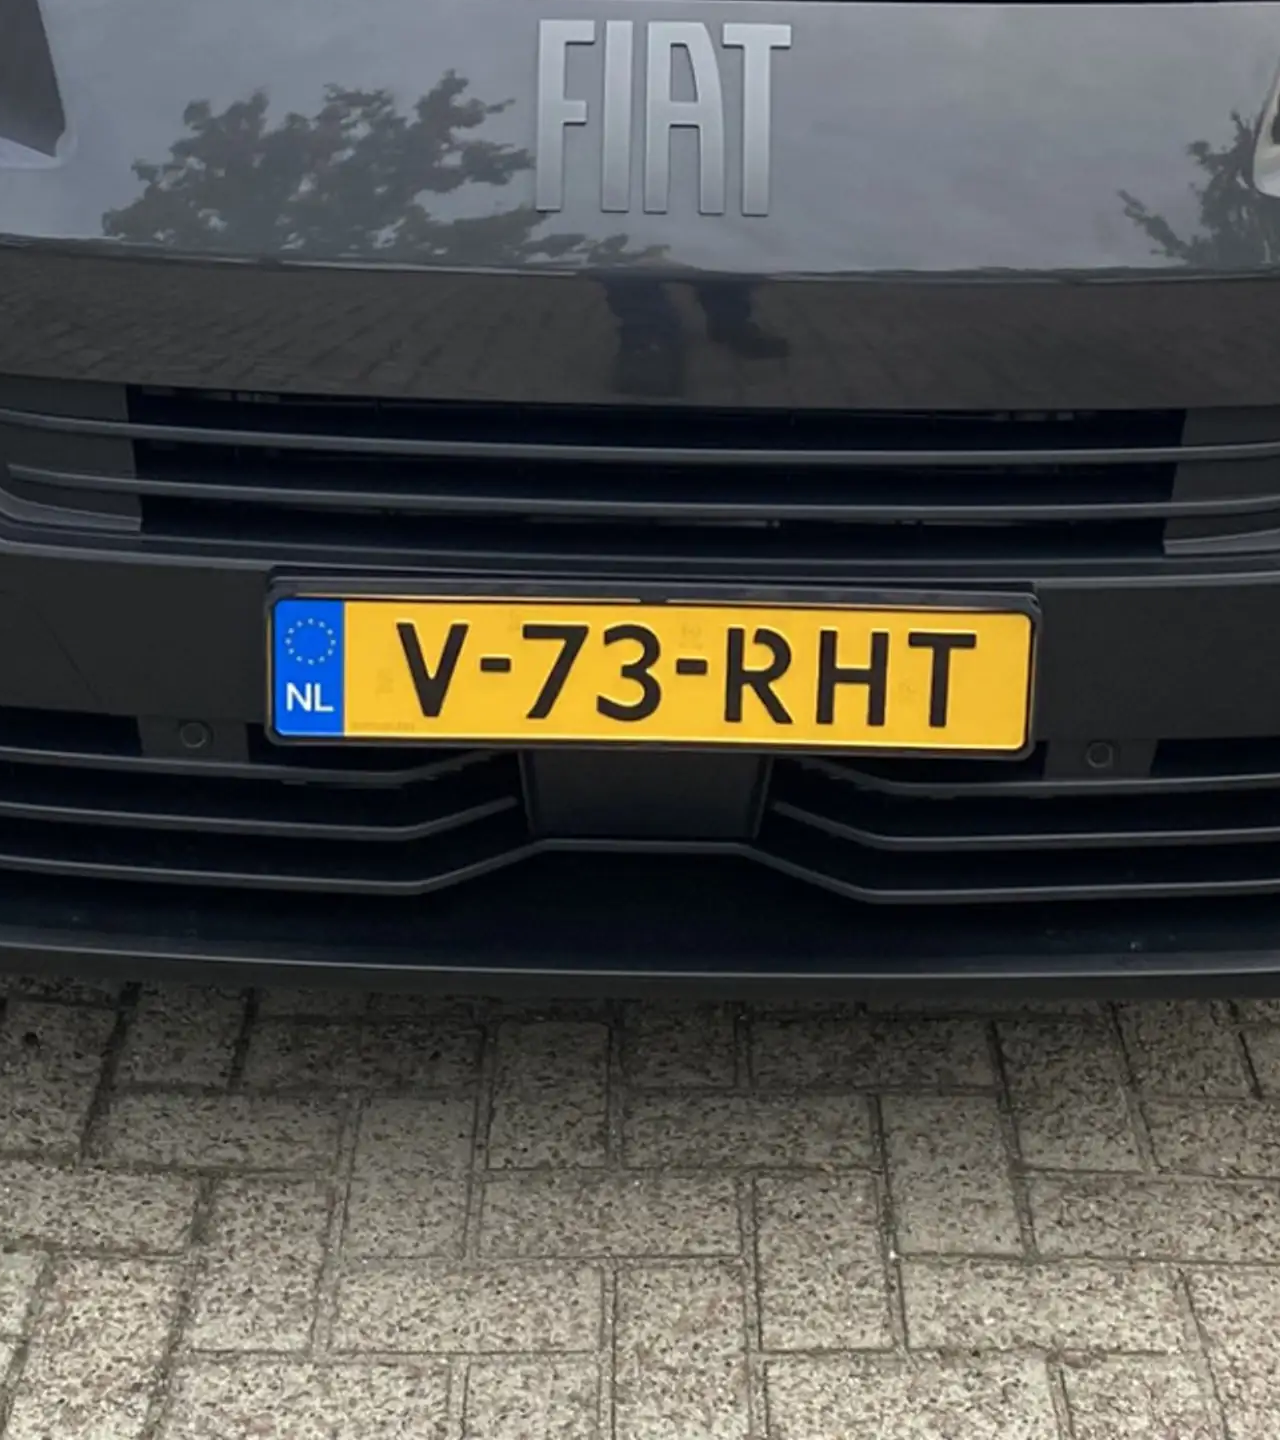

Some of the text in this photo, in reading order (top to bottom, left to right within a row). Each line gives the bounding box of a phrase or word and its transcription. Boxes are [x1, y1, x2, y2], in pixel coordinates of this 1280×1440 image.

[535, 19, 791, 216] FIAT
[286, 681, 335, 712] NL
[397, 620, 977, 728] V-73-RHT
